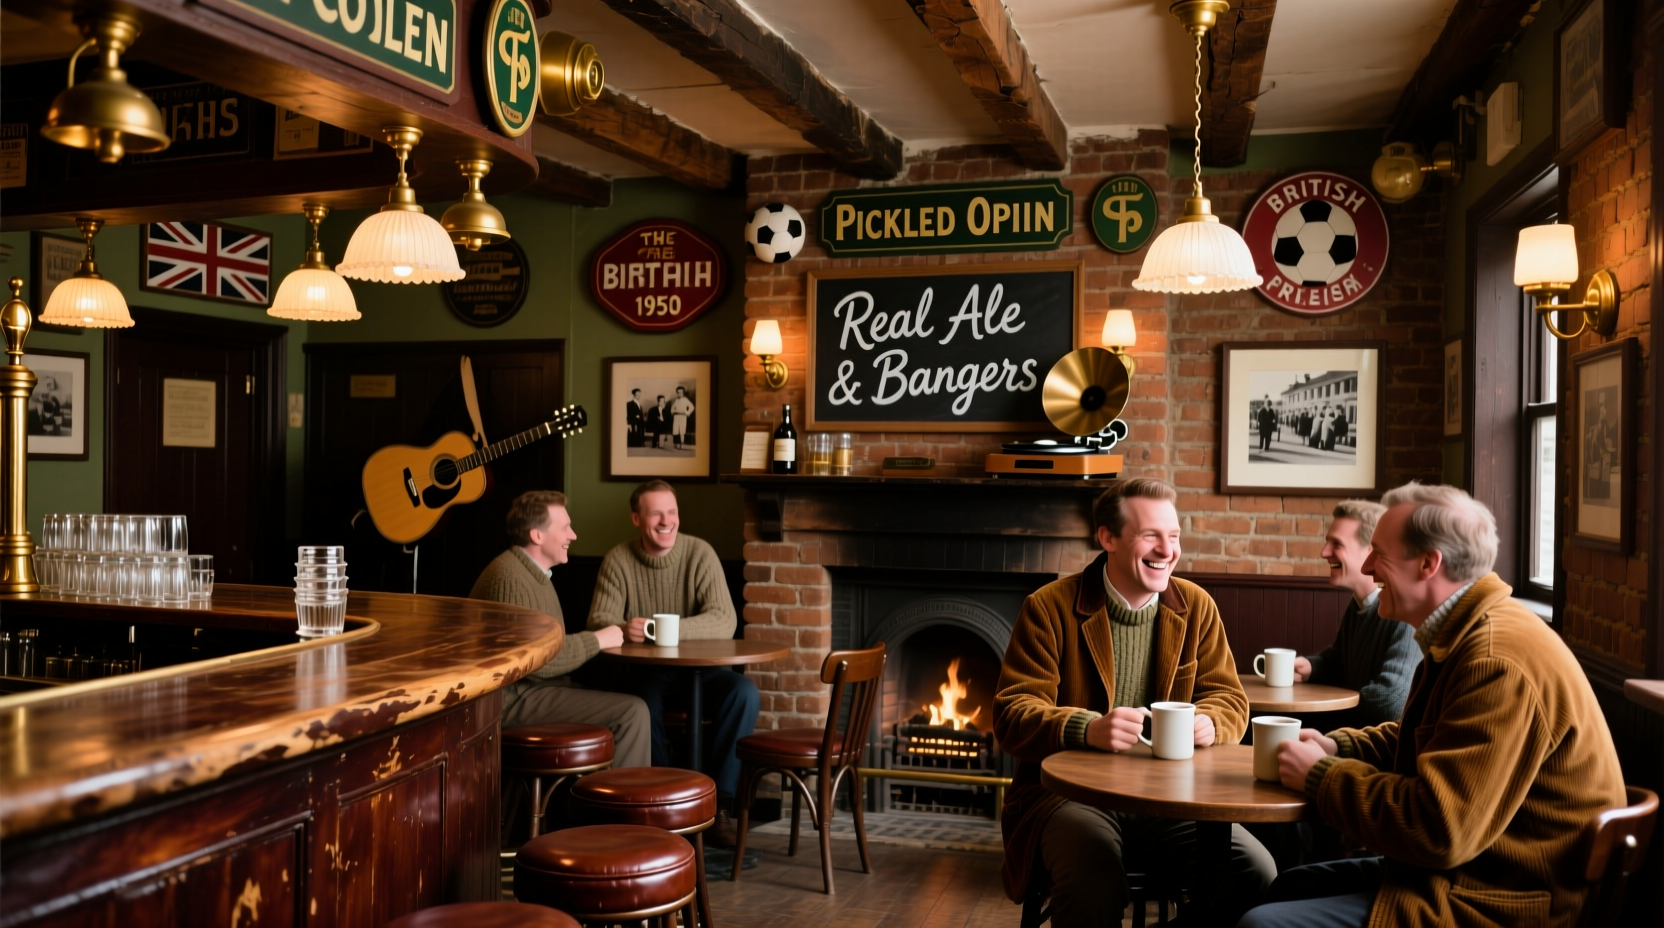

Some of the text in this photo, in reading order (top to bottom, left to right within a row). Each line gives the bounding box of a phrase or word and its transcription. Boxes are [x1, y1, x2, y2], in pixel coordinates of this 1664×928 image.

[1267, 179, 1366, 214] BRITISH
[640, 231, 677, 246] THE
[836, 204, 956, 240] PICKLED
[635, 295, 682, 317] 1950
[834, 283, 1026, 350] Real Ale
[828, 349, 1038, 416] & Bangers
